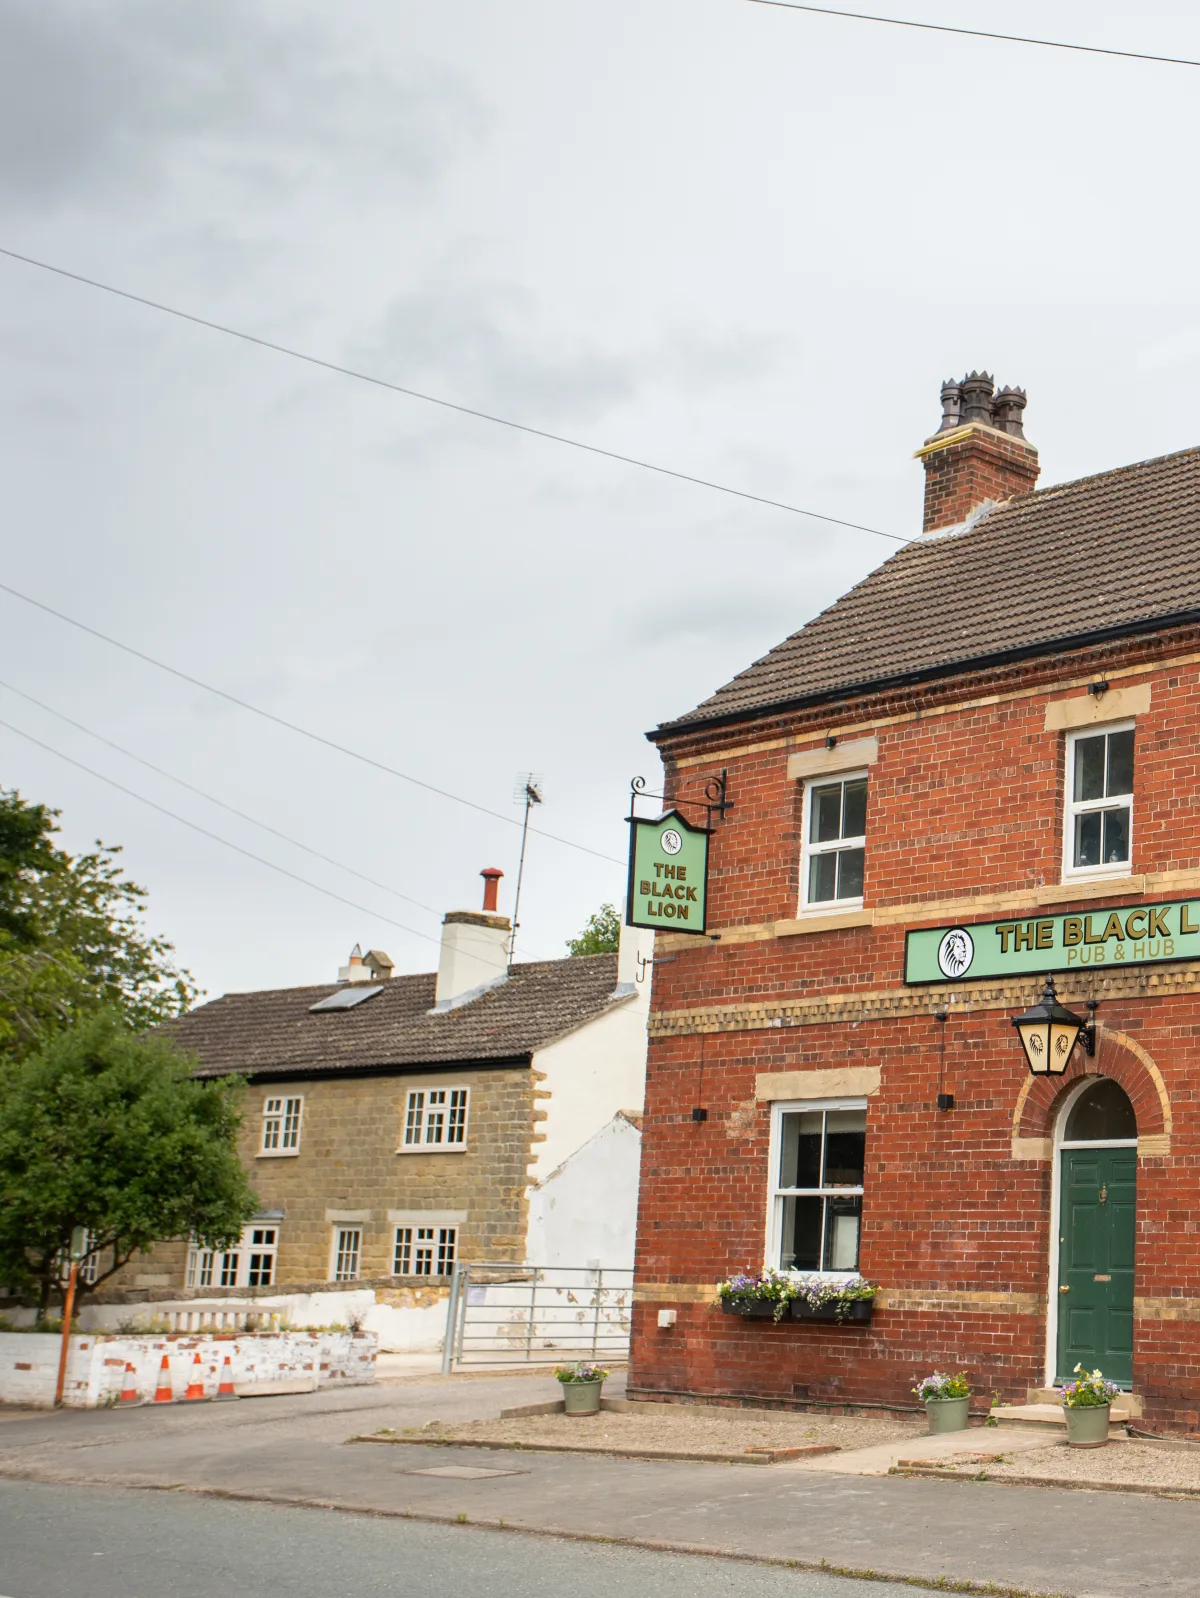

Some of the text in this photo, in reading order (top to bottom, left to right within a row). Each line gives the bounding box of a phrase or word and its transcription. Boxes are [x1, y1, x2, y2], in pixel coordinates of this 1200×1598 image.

[654, 862, 687, 881] THE
[640, 880, 698, 901] BLACK
[647, 901, 689, 920] LION
[996, 920, 1054, 954] THE
[1063, 907, 1171, 947] BLACK
[1067, 938, 1175, 966] PUB & HUB
